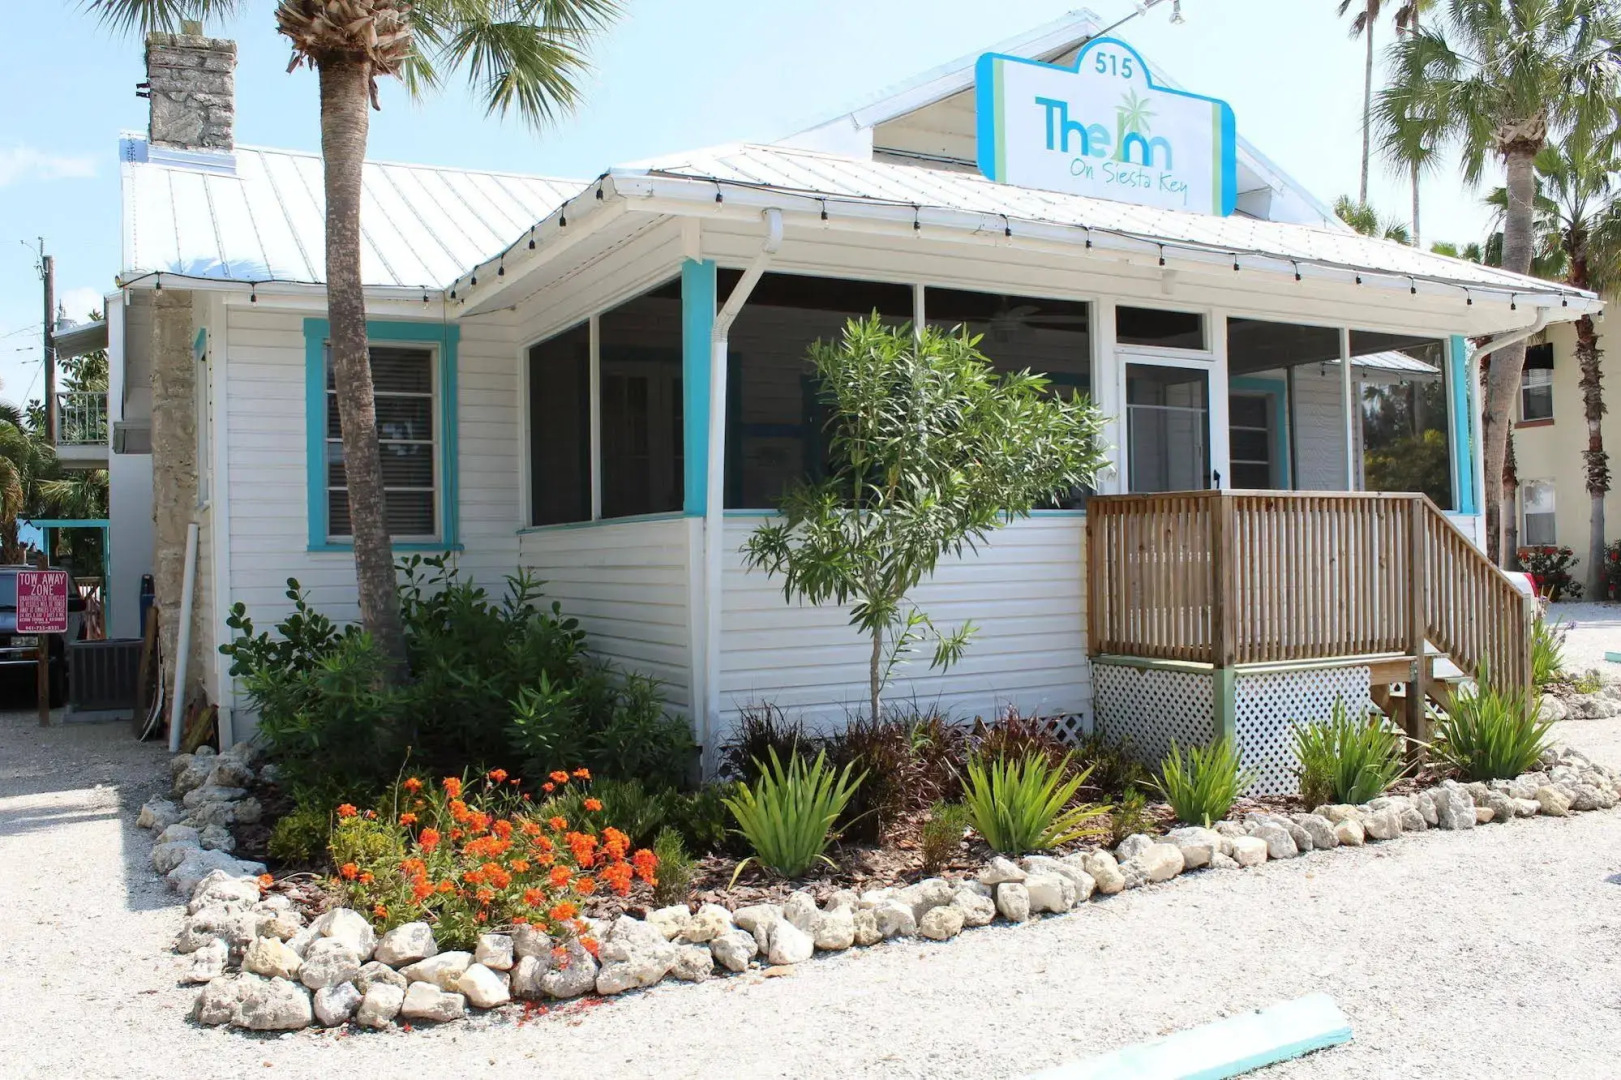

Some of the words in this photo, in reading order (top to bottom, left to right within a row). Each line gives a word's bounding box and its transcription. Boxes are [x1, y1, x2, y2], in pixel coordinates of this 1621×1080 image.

[1095, 51, 1133, 80] 515
[1034, 96, 1111, 159] The
[1069, 158, 1095, 180] On
[1102, 162, 1152, 189] Siesta
[1158, 172, 1189, 205] Key
[20, 573, 38, 585] TOW
[42, 573, 65, 585] AWAY
[31, 584, 54, 596] ZONE
